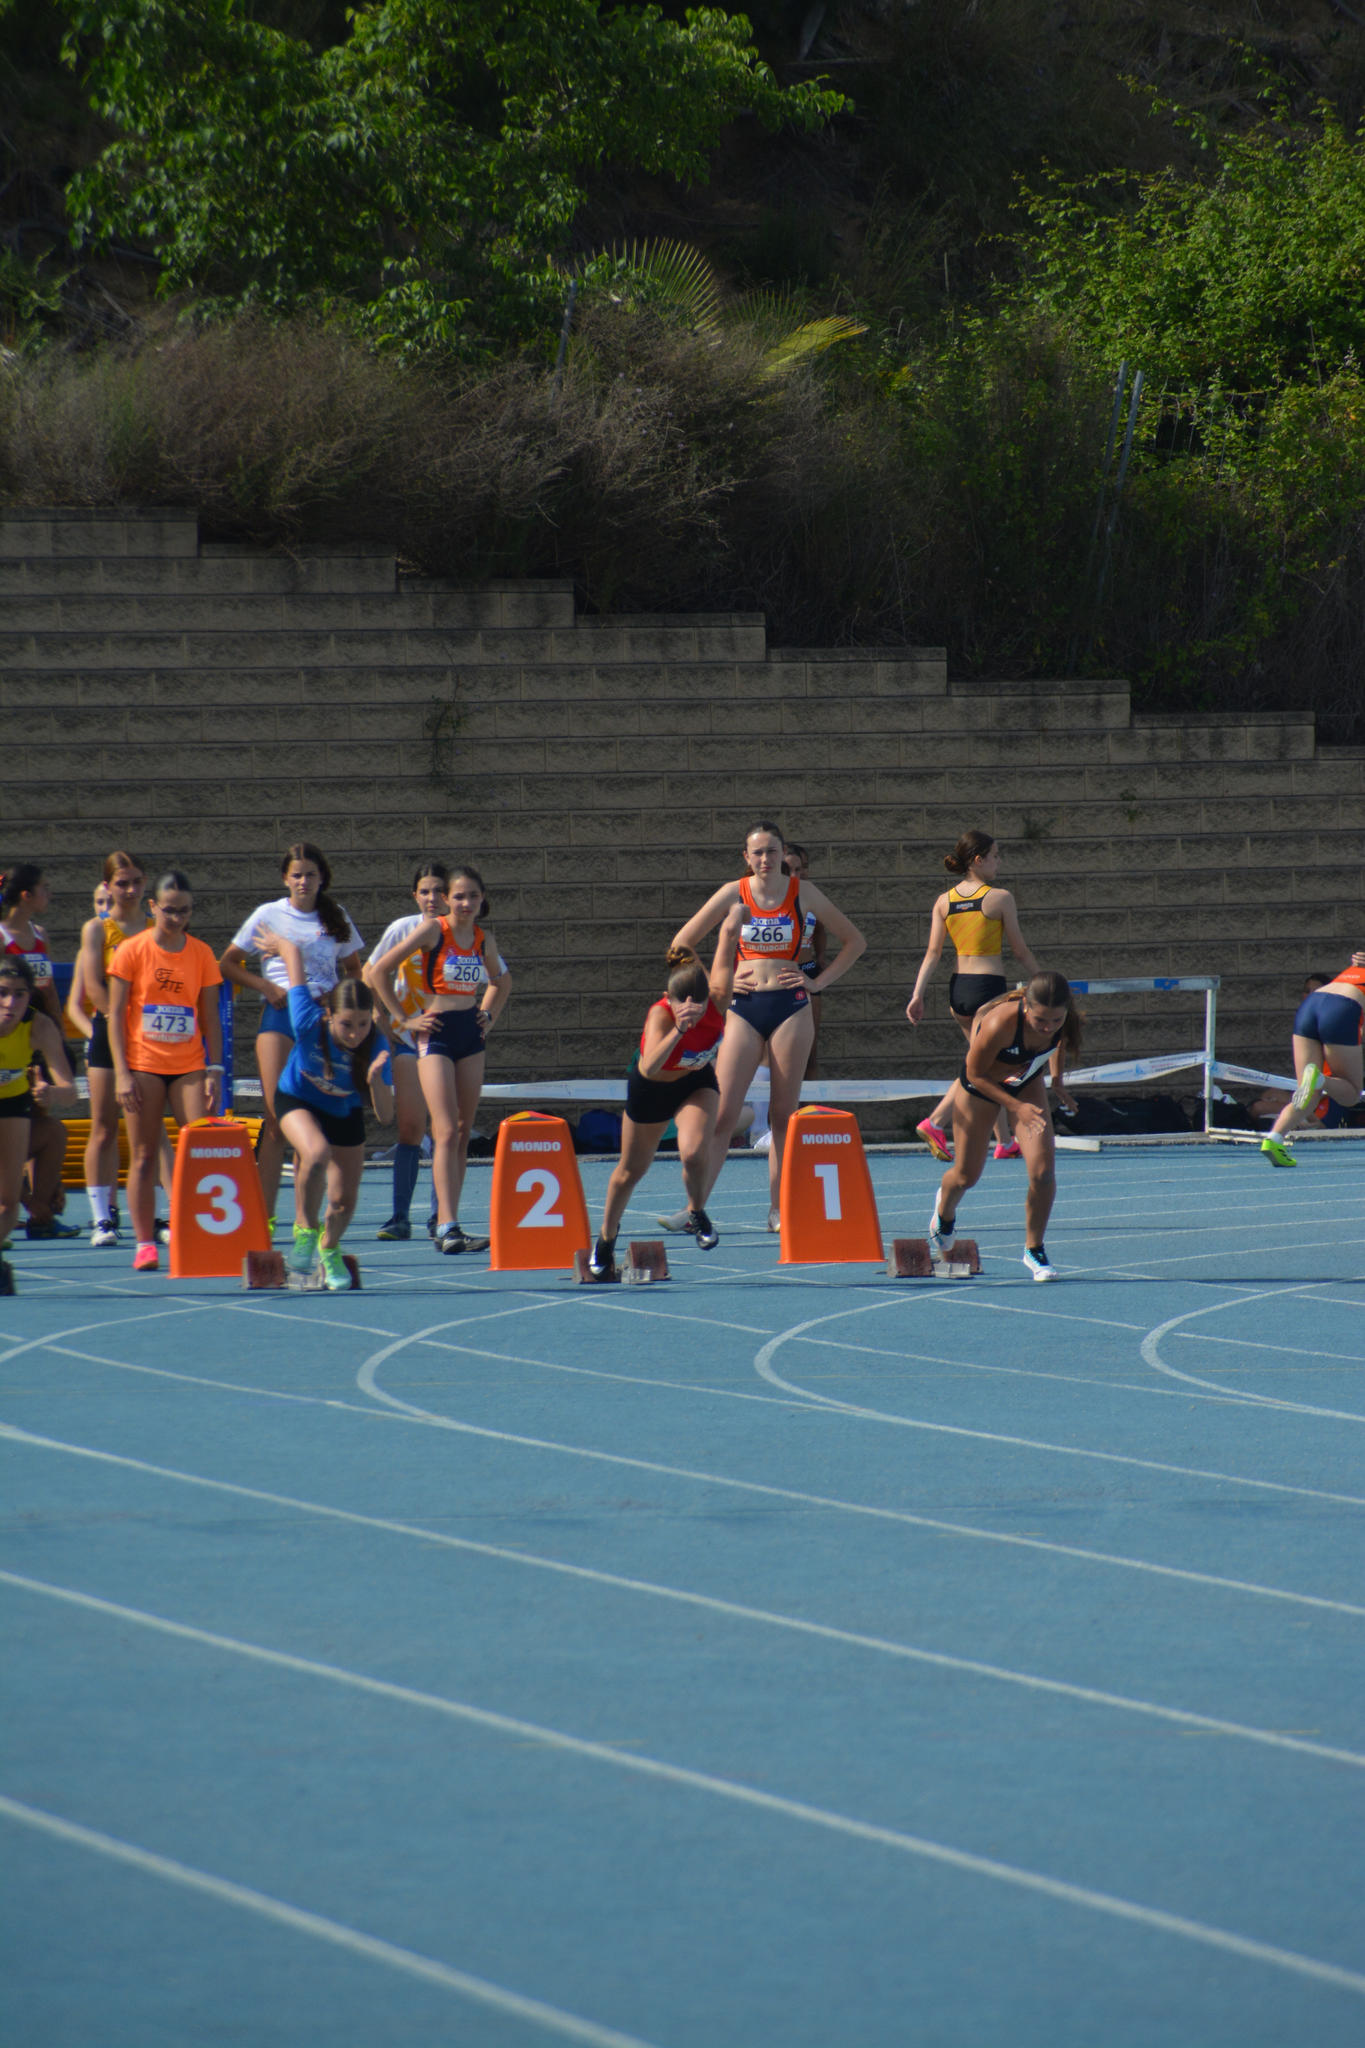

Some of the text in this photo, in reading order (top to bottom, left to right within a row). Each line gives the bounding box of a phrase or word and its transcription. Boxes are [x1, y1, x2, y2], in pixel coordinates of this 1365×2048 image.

[750, 926, 784, 942] 266
[453, 966, 480, 982] 260
[151, 1015, 188, 1032] 473
[511, 1141, 562, 1152] MONDO
[802, 1133, 852, 1145] MONDO
[190, 1147, 242, 1158] MONDO
[515, 1168, 565, 1228] 2
[814, 1163, 842, 1220] 1
[195, 1173, 244, 1235] 3
